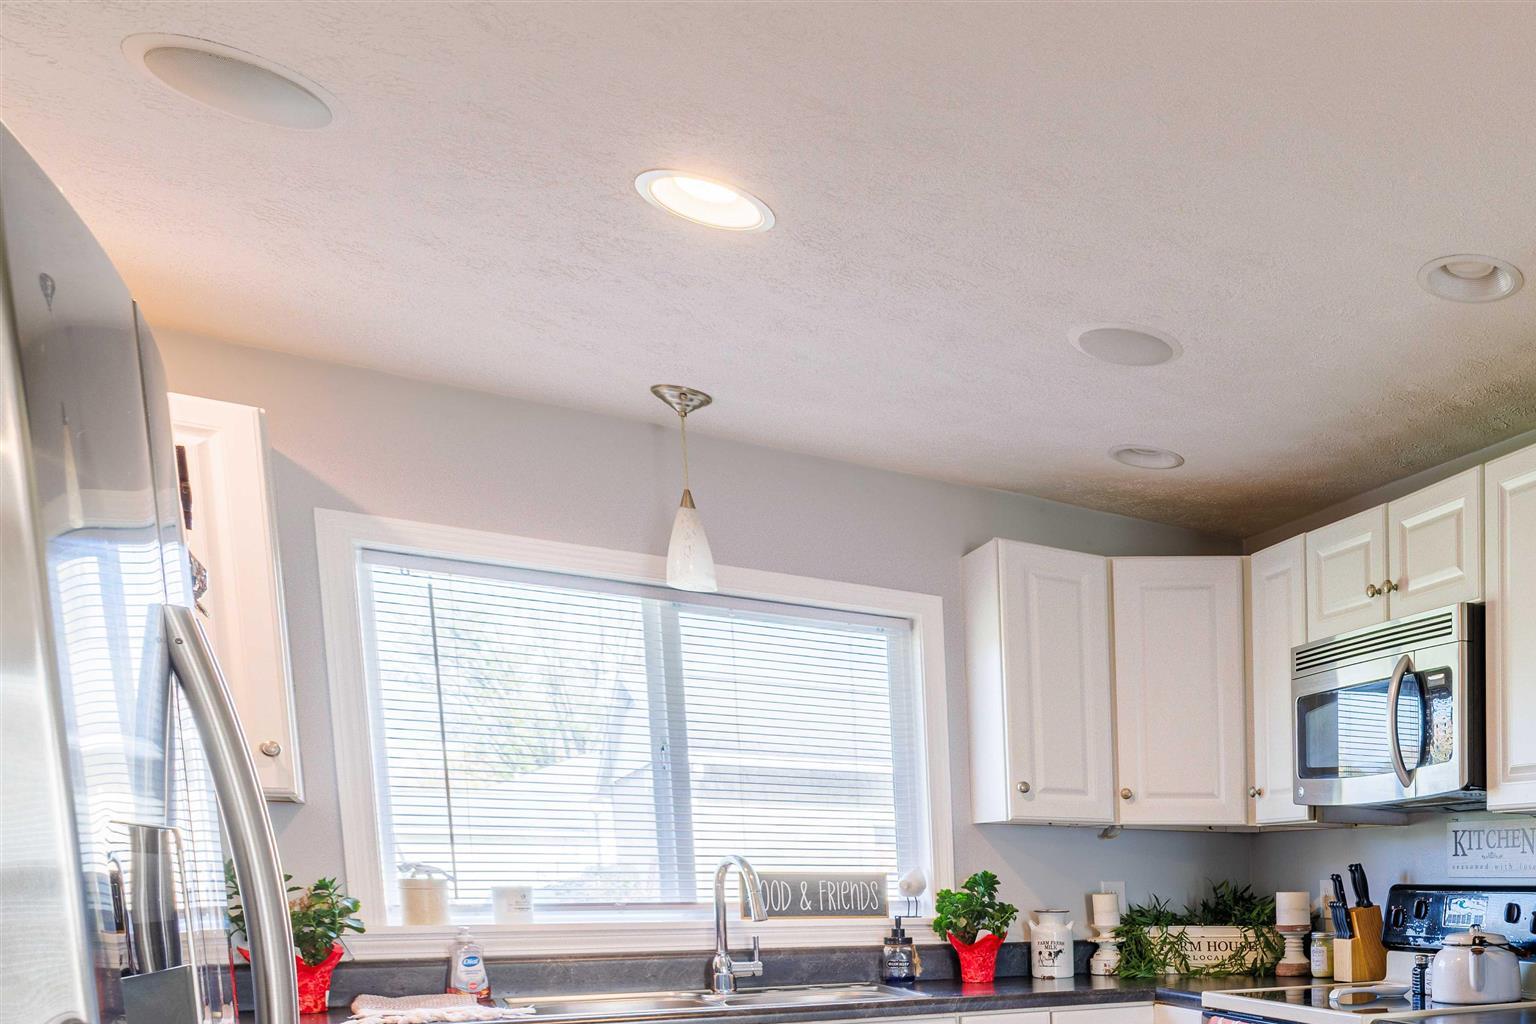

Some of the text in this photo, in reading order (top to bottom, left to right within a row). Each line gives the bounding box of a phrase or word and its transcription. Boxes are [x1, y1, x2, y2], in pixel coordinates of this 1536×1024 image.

[1452, 828, 1536, 857] KITCHEN
[759, 880, 792, 912] OOD
[800, 880, 812, 911] &
